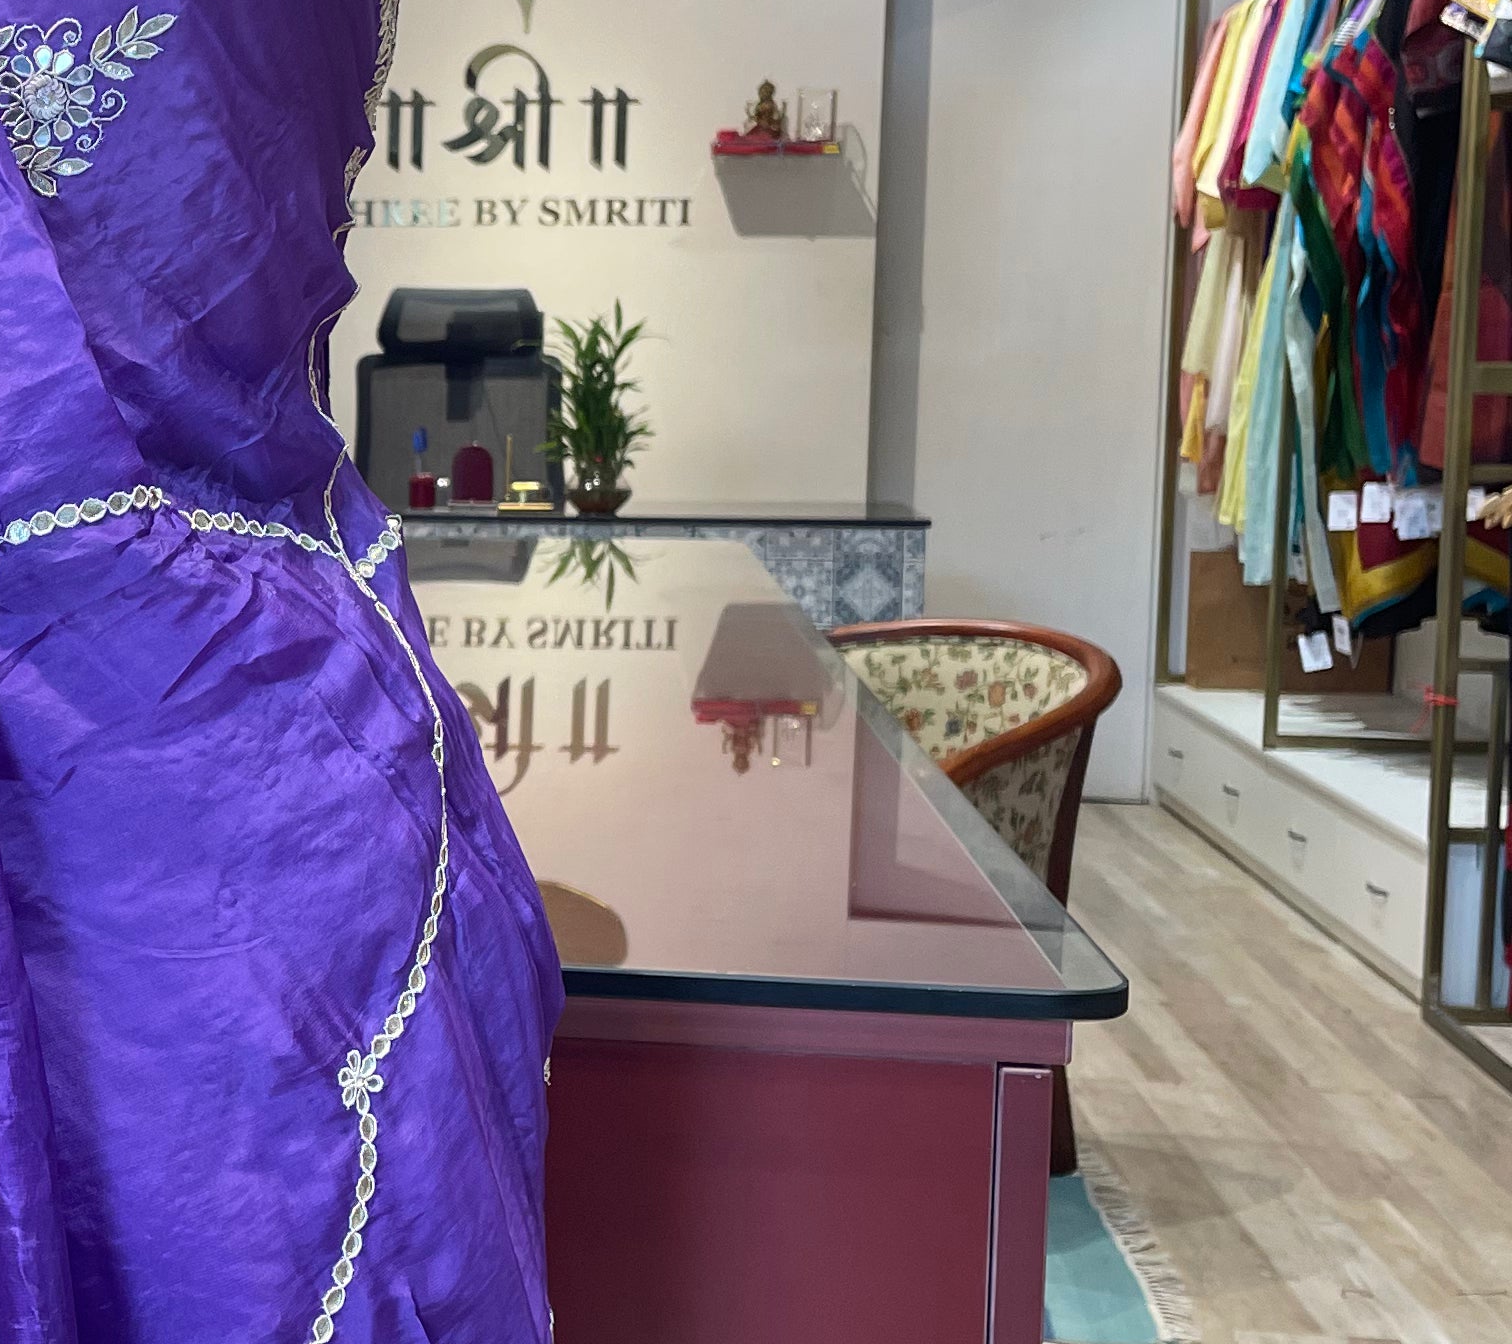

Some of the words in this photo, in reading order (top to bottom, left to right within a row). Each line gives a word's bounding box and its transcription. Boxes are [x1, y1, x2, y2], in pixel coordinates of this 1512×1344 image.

[441, 44, 564, 173] श्री
[350, 197, 461, 228] HREE
[473, 197, 529, 228] BY
[537, 197, 692, 228] SMRITI
